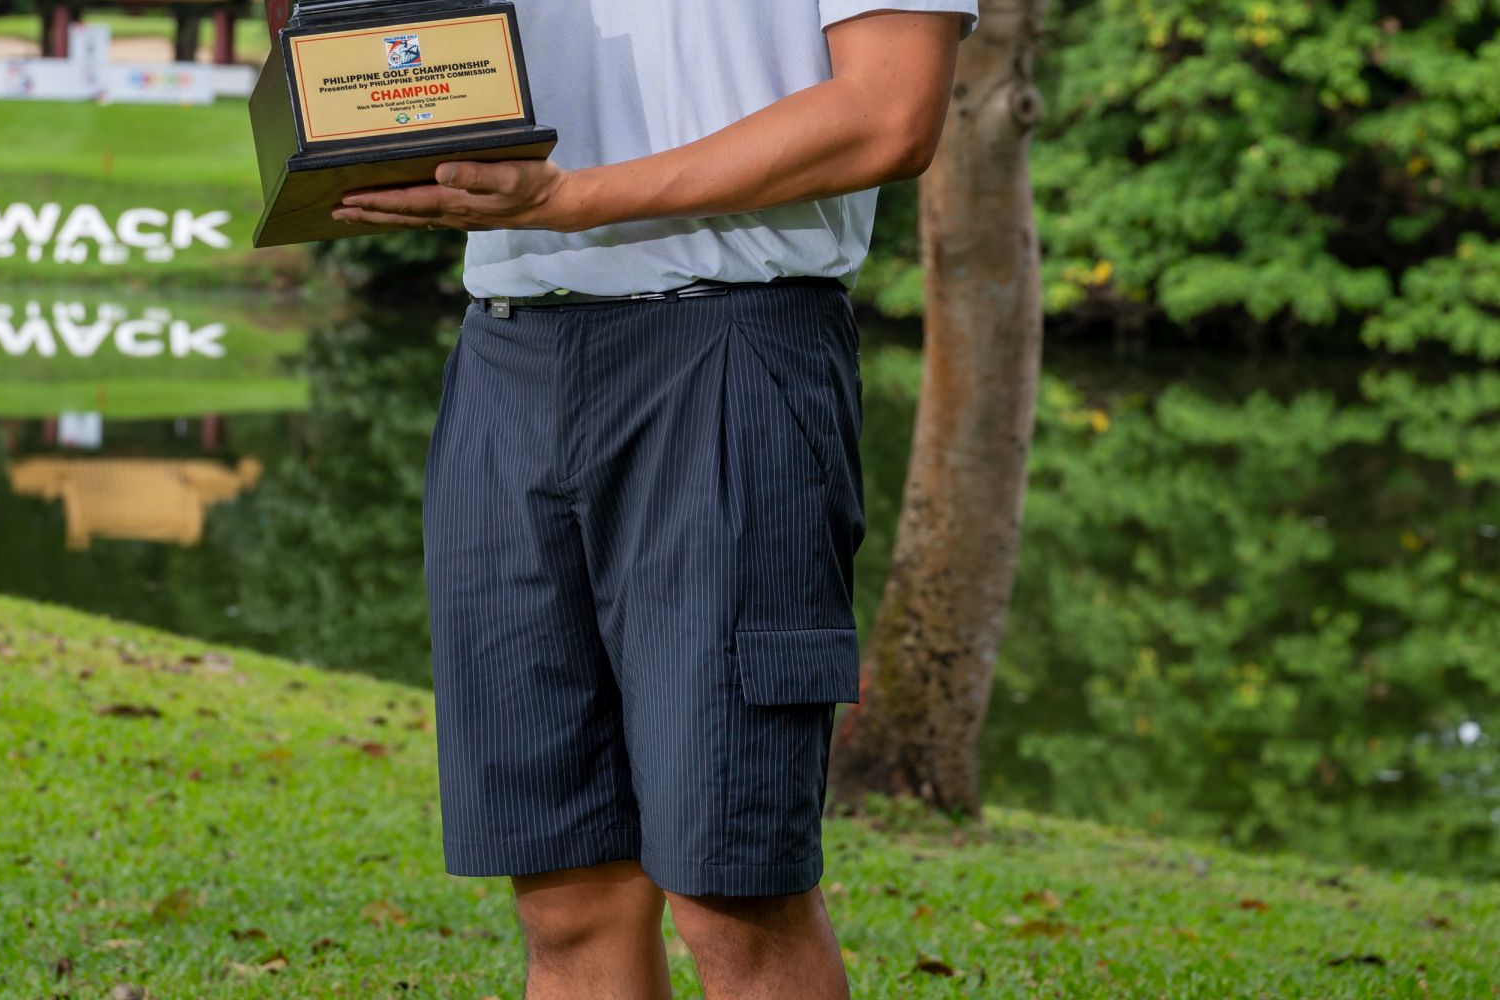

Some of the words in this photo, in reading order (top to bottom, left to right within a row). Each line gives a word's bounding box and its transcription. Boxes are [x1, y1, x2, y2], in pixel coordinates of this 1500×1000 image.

[319, 83, 357, 93] Presented
[369, 77, 413, 87] PHILIPPINE
[415, 73, 445, 82] SPORTS
[447, 67, 497, 79] COMMISSION
[323, 72, 380, 86] PHILIPPINE
[383, 69, 410, 79] GOLF
[412, 60, 490, 76] CHAMPIONSHIP
[370, 83, 450, 102] CHAMPION
